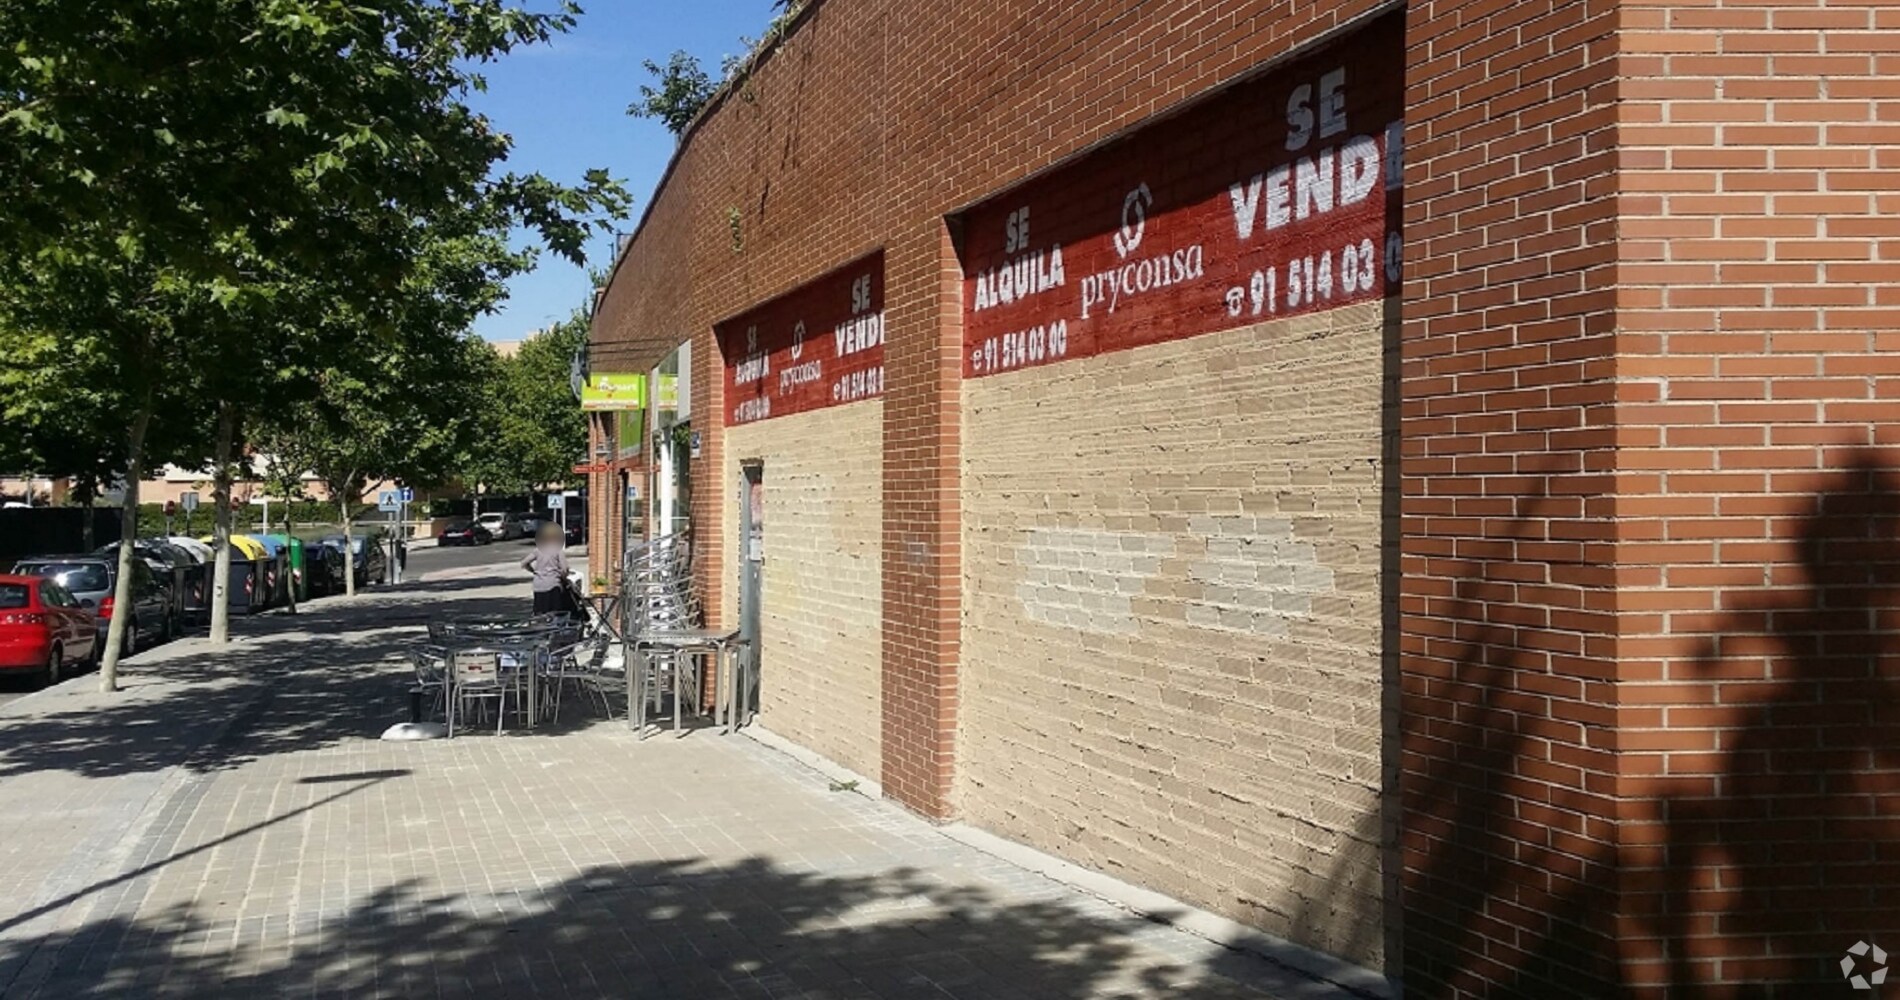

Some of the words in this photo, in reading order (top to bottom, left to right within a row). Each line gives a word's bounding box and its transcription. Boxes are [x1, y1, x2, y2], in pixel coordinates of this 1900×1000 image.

[1285, 66, 1347, 151] SE
[1005, 206, 1030, 254] SE
[852, 274, 871, 315] SE
[974, 243, 1065, 312] ALQUILA
[1080, 245, 1204, 319] pryconsa
[1251, 266, 1276, 315] 91
[1287, 250, 1333, 307] 514
[1342, 238, 1375, 292] 03
[835, 309, 885, 357] VEND
[984, 337, 998, 371] 91
[1003, 331, 1026, 367] 514
[1029, 325, 1044, 360] 03
